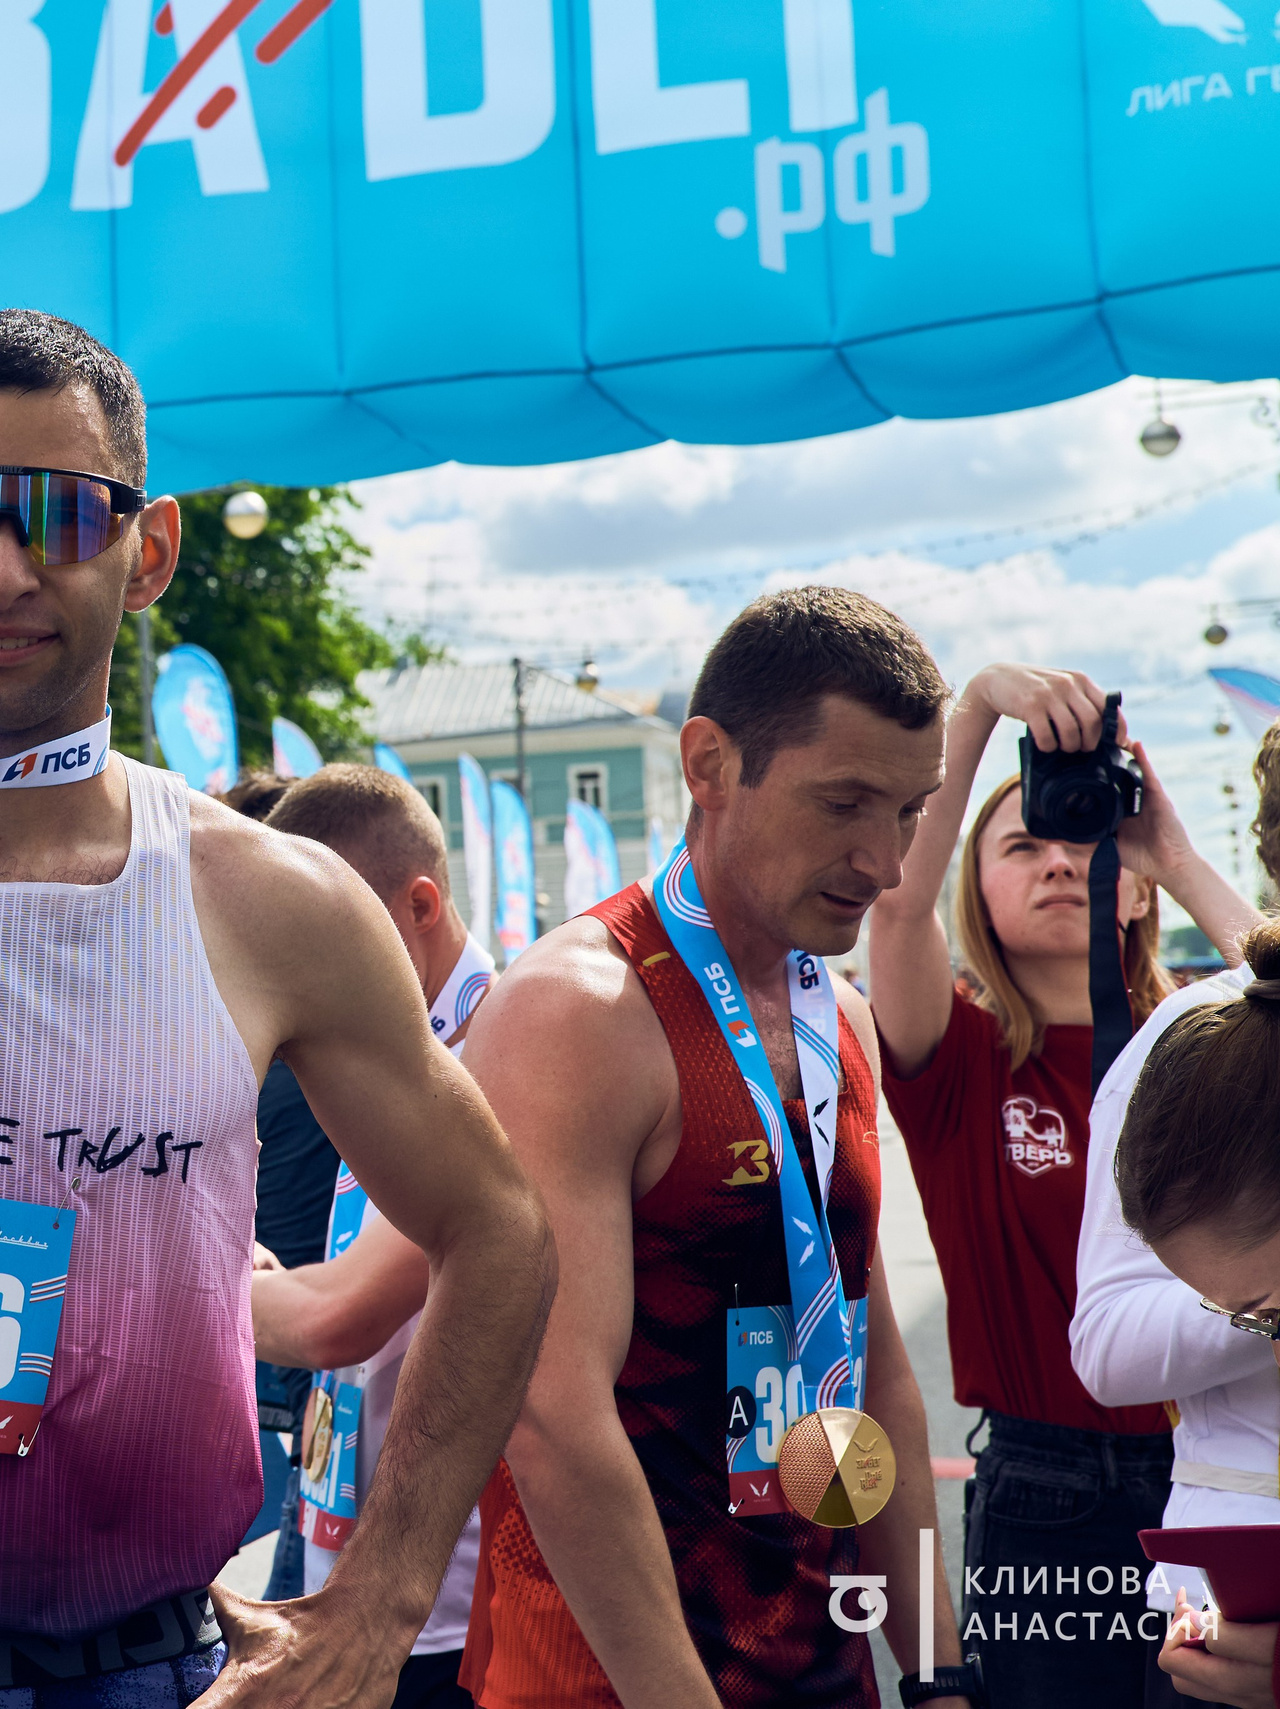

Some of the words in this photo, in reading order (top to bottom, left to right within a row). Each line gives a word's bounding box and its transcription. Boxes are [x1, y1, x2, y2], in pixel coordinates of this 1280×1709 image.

[1125, 72, 1233, 117] ЛИГА
[41, 742, 91, 774] ПСБ
[704, 962, 740, 1015] ПСБ
[749, 1331, 774, 1345] ПСБ
